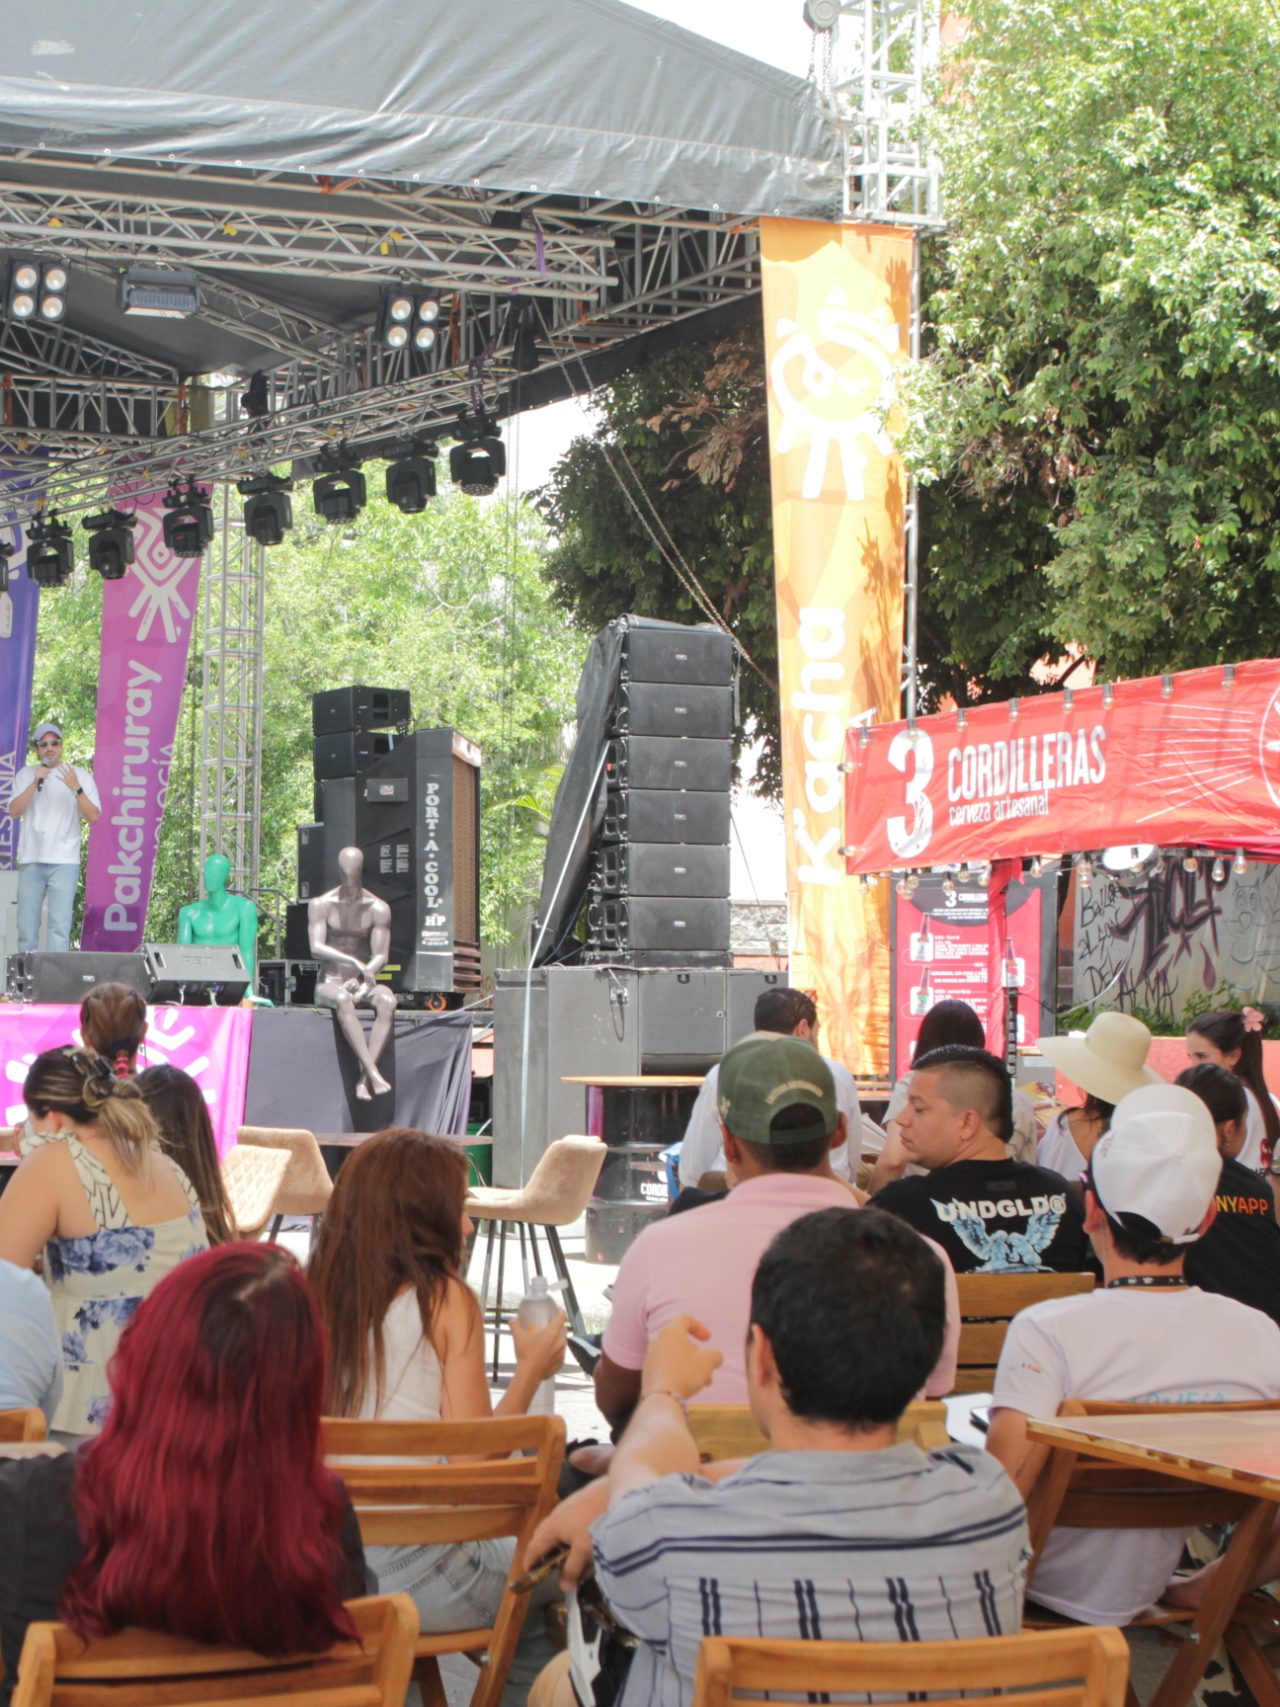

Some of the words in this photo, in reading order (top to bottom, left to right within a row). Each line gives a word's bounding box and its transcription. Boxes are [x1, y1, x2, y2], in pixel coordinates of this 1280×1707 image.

[947, 725, 1107, 803] CORDILLERAS
[104, 660, 162, 931] Pakchiruray
[887, 729, 935, 858] 3
[949, 801, 991, 827] cerveza
[994, 789, 1050, 821] artesanal
[945, 889, 957, 907] 3
[1215, 1195, 1268, 1216] NYAPP
